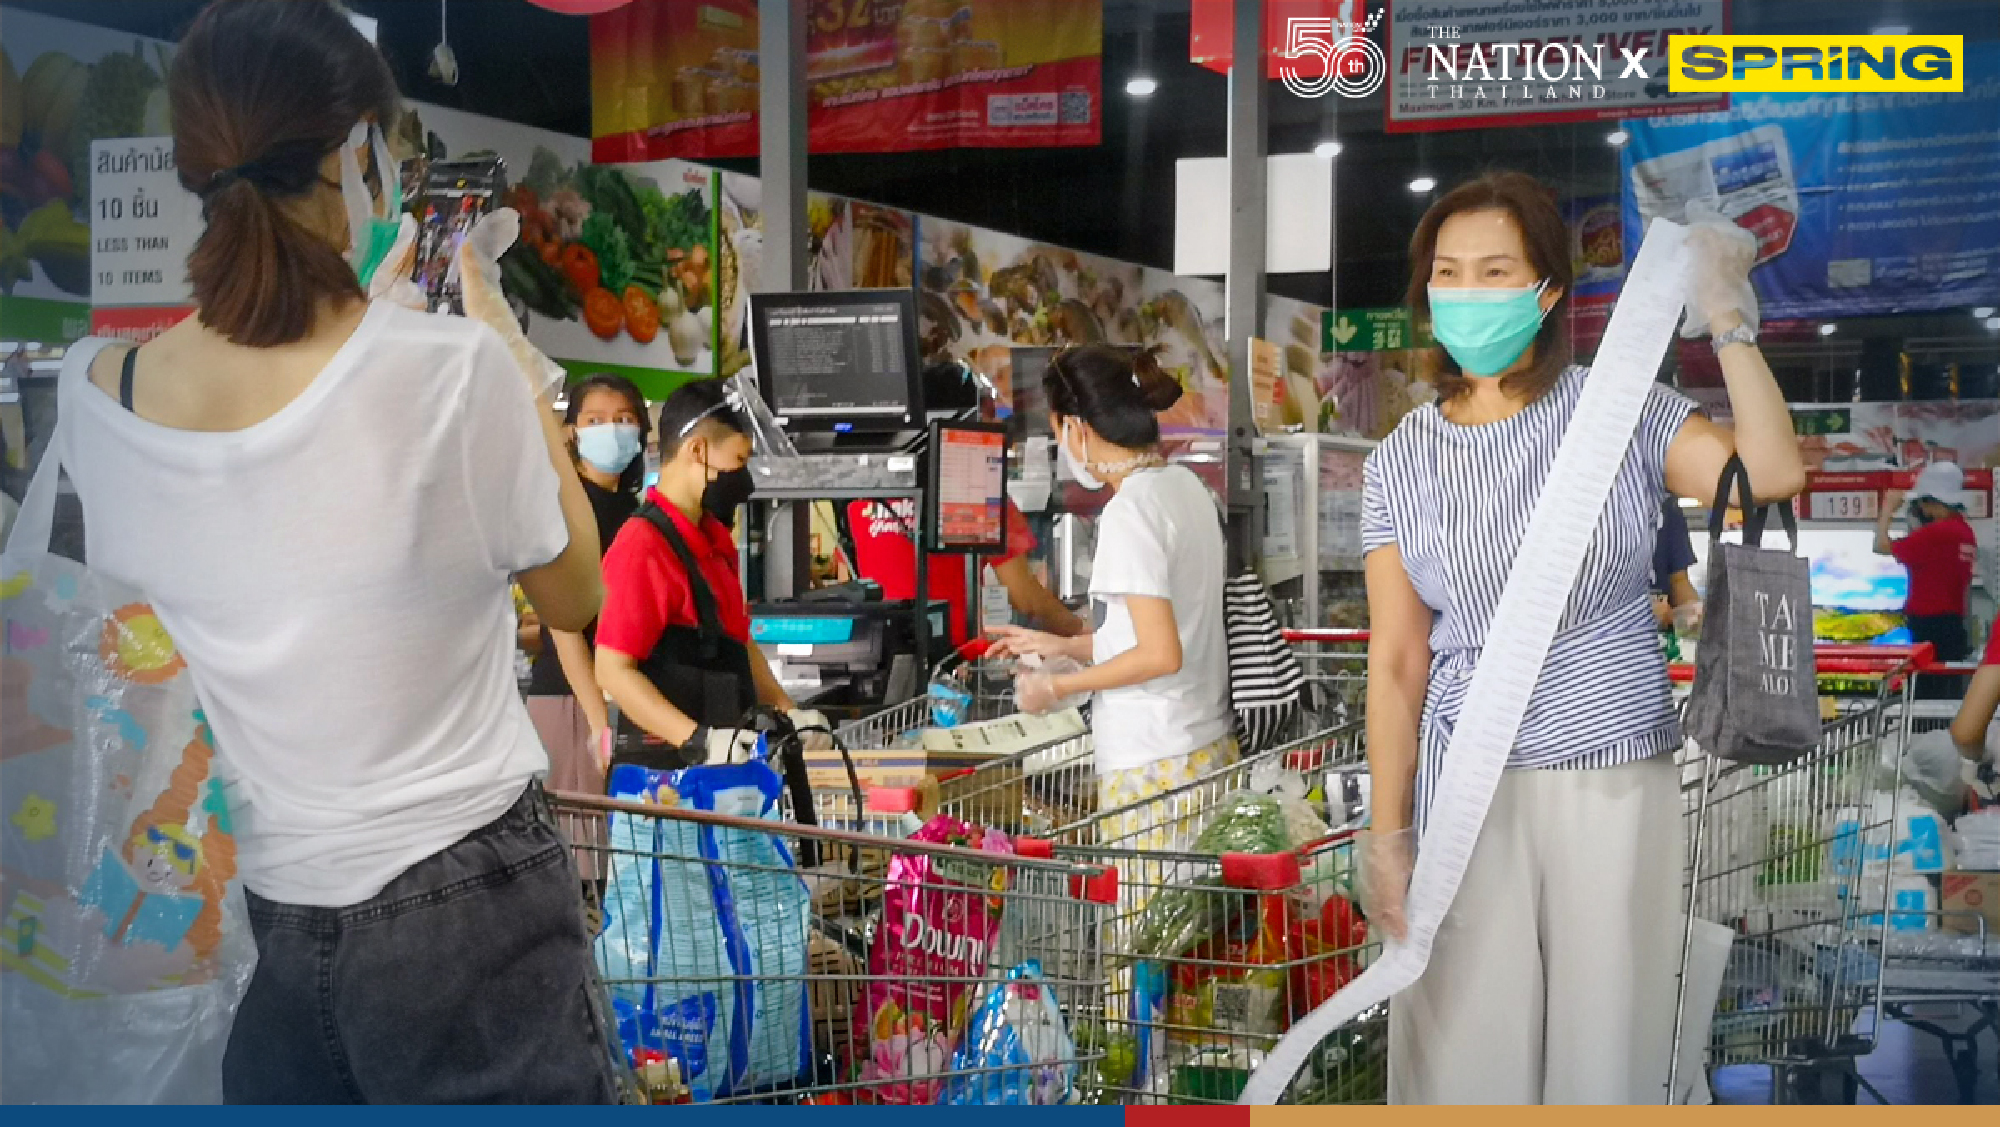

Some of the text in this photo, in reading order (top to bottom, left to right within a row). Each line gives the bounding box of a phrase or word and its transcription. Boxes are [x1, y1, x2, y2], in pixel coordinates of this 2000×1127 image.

[98, 198, 123, 220] 10
[97, 236, 169, 253] LESS THAN
[98, 270, 163, 286] 10 ITEMS
[1829, 497, 1862, 516] 139
